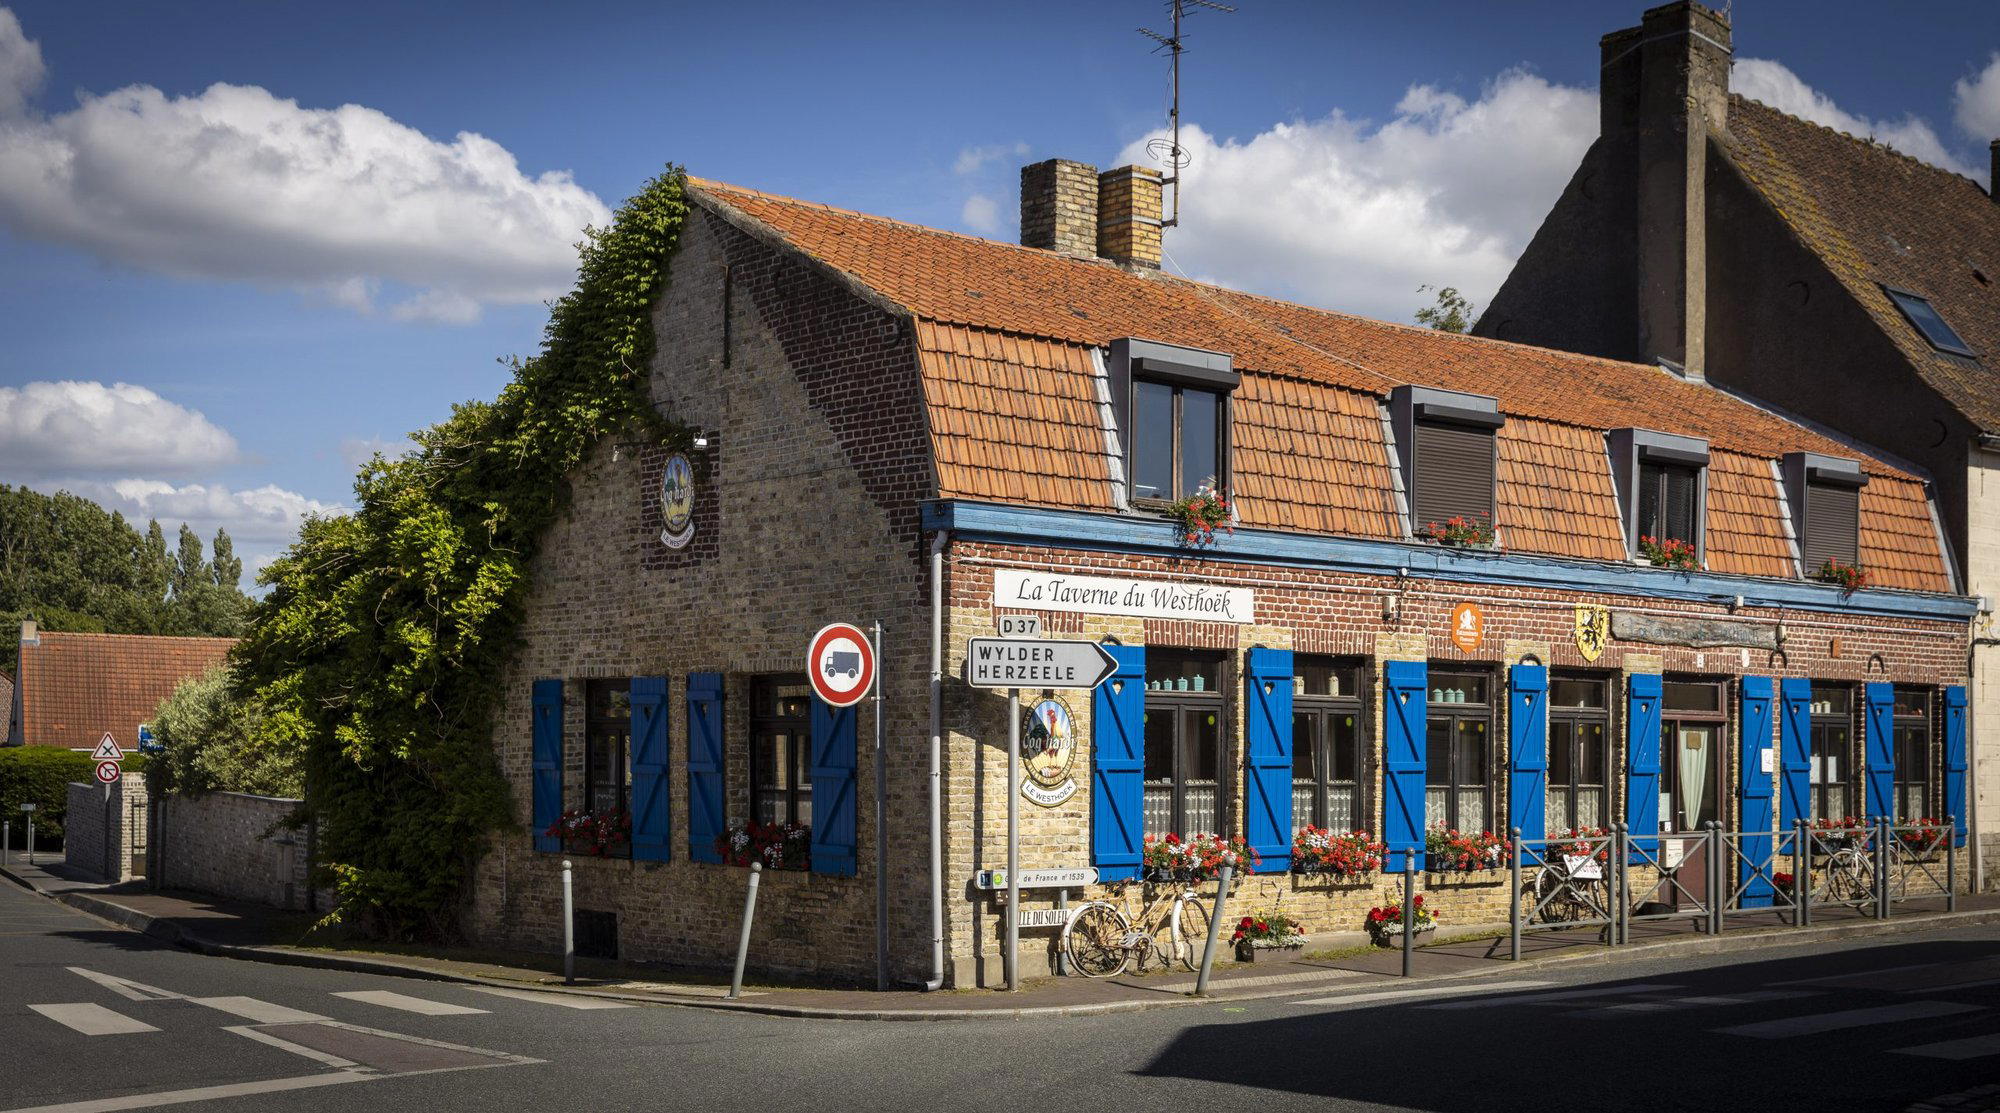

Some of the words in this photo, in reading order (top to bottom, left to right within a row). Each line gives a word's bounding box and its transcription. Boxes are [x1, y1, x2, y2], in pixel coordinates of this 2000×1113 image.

[1017, 578, 1043, 601] La
[1048, 579, 1118, 606] Taverne
[1123, 583, 1146, 608] du
[1150, 586, 1236, 619] Westhoëk
[1003, 620, 1013, 633] D
[1017, 620, 1036, 634] 37
[979, 646, 1054, 661] WYLDER
[978, 665, 1075, 680] HERZEELE
[1022, 734, 1043, 752] Coq
[1025, 784, 1035, 797] LE
[1035, 784, 1073, 803] WESTHOEK
[1023, 874, 1032, 883] de
[1035, 874, 1058, 882] France
[1033, 911, 1044, 926] DU
